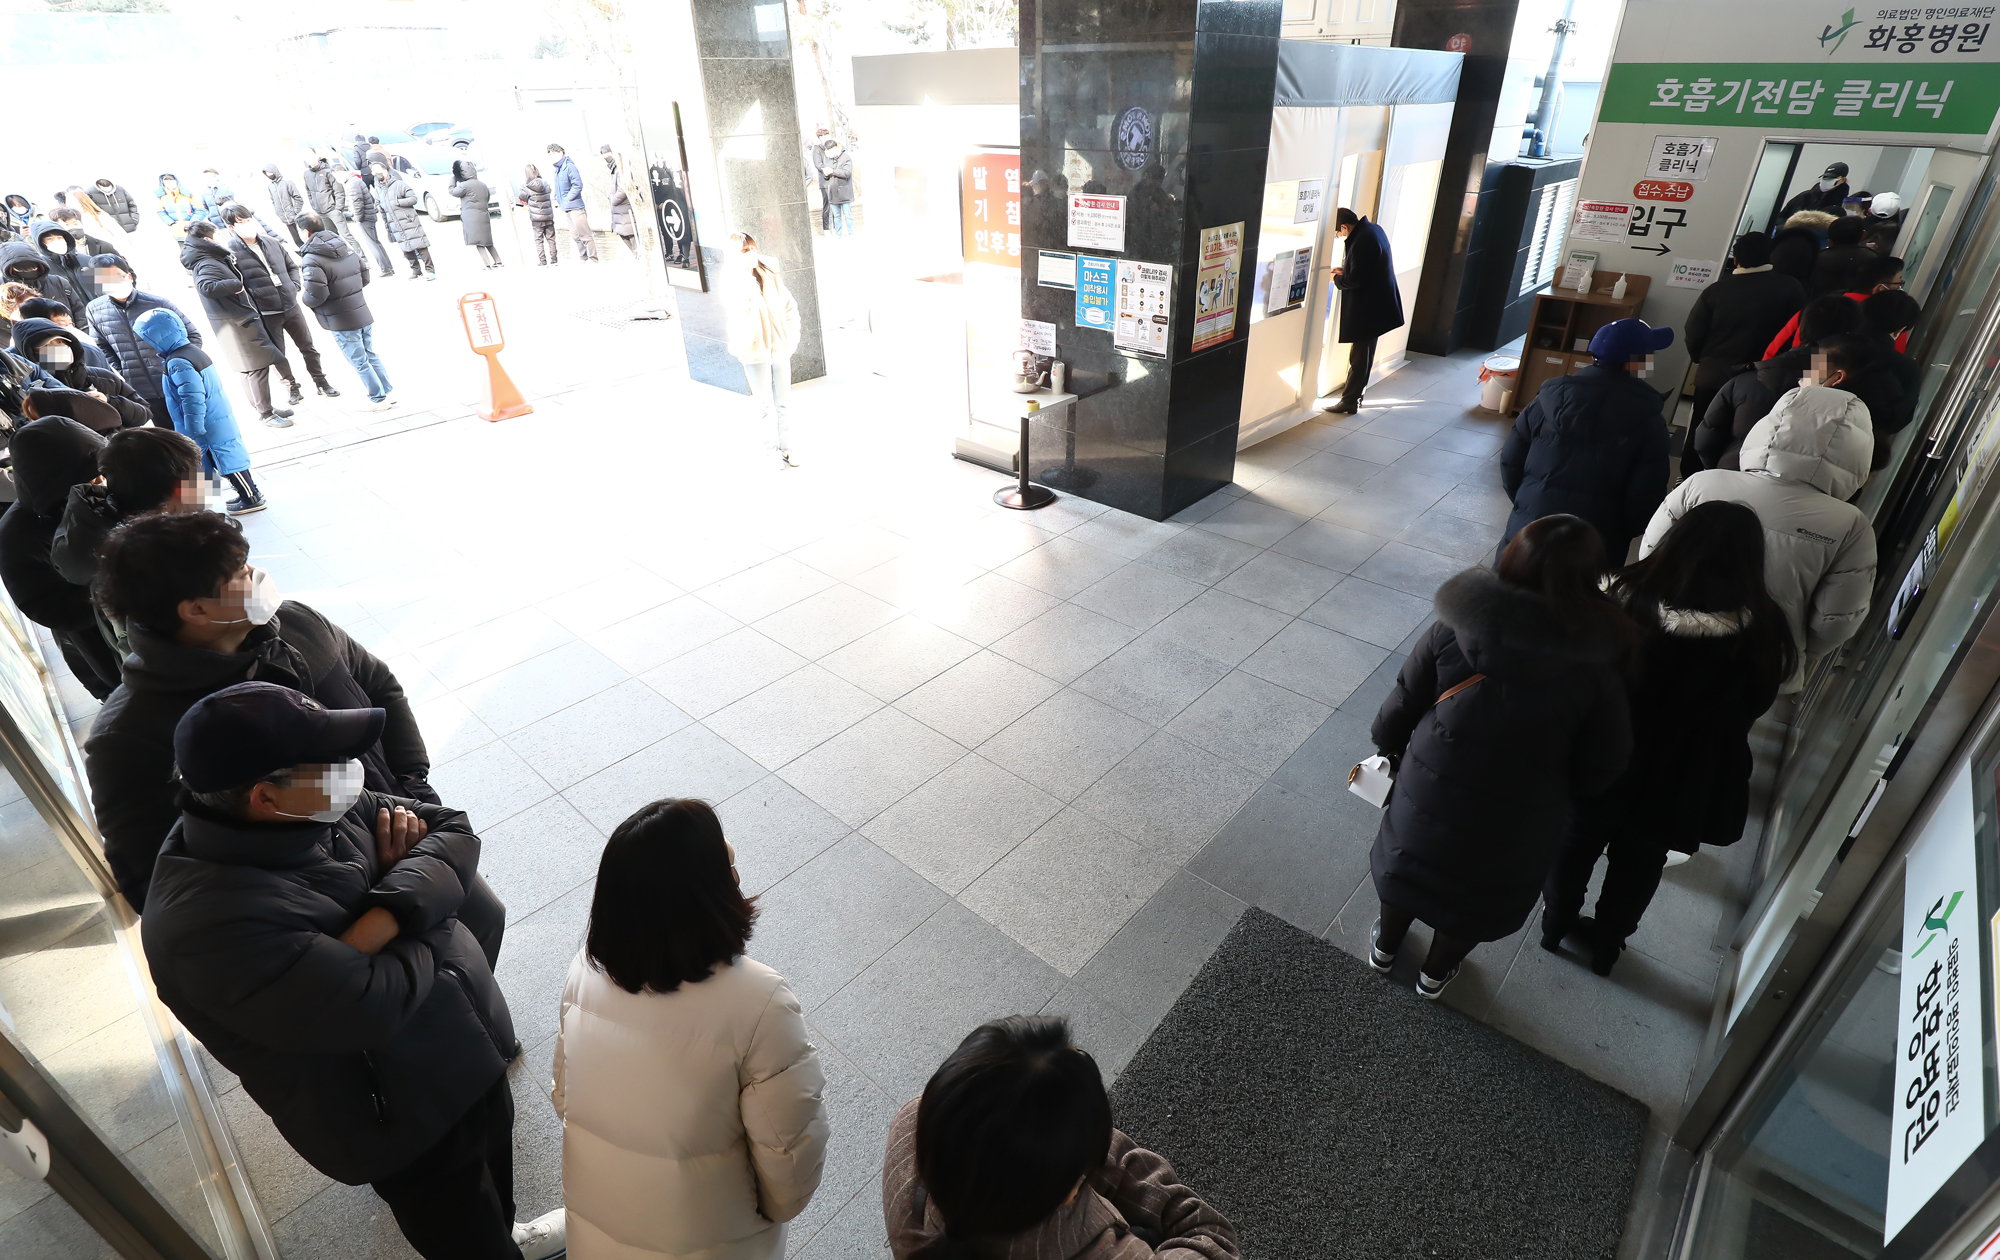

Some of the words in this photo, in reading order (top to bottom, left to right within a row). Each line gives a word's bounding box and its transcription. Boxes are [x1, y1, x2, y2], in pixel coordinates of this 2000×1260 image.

[1876, 9, 1922, 20] 의료법인
[1925, 6, 1996, 20] 명인의료재단
[1863, 23, 1991, 54] 화홍병원
[1649, 77, 1826, 115] 호흡기전담
[1833, 80, 1955, 119] 클리닉
[1662, 142, 1704, 157] 호흡기
[1658, 158, 1699, 173] 클리닉
[972, 166, 988, 190] 발
[1004, 168, 1020, 193] 열
[974, 198, 988, 222] 기
[1005, 200, 1020, 226] 침
[1628, 205, 1688, 239] 입구
[974, 229, 1021, 256] 인후통
[1083, 270, 1109, 284] 마스크
[1083, 283, 1108, 295] 미착용시
[1082, 294, 1109, 306] 출입불가
[473, 302, 493, 344] 주차금지
[1946, 937, 1960, 1006] 의료법인
[1904, 958, 1944, 1166] 화홍병원
[1946, 1002, 1960, 1118] 명인의료재단
